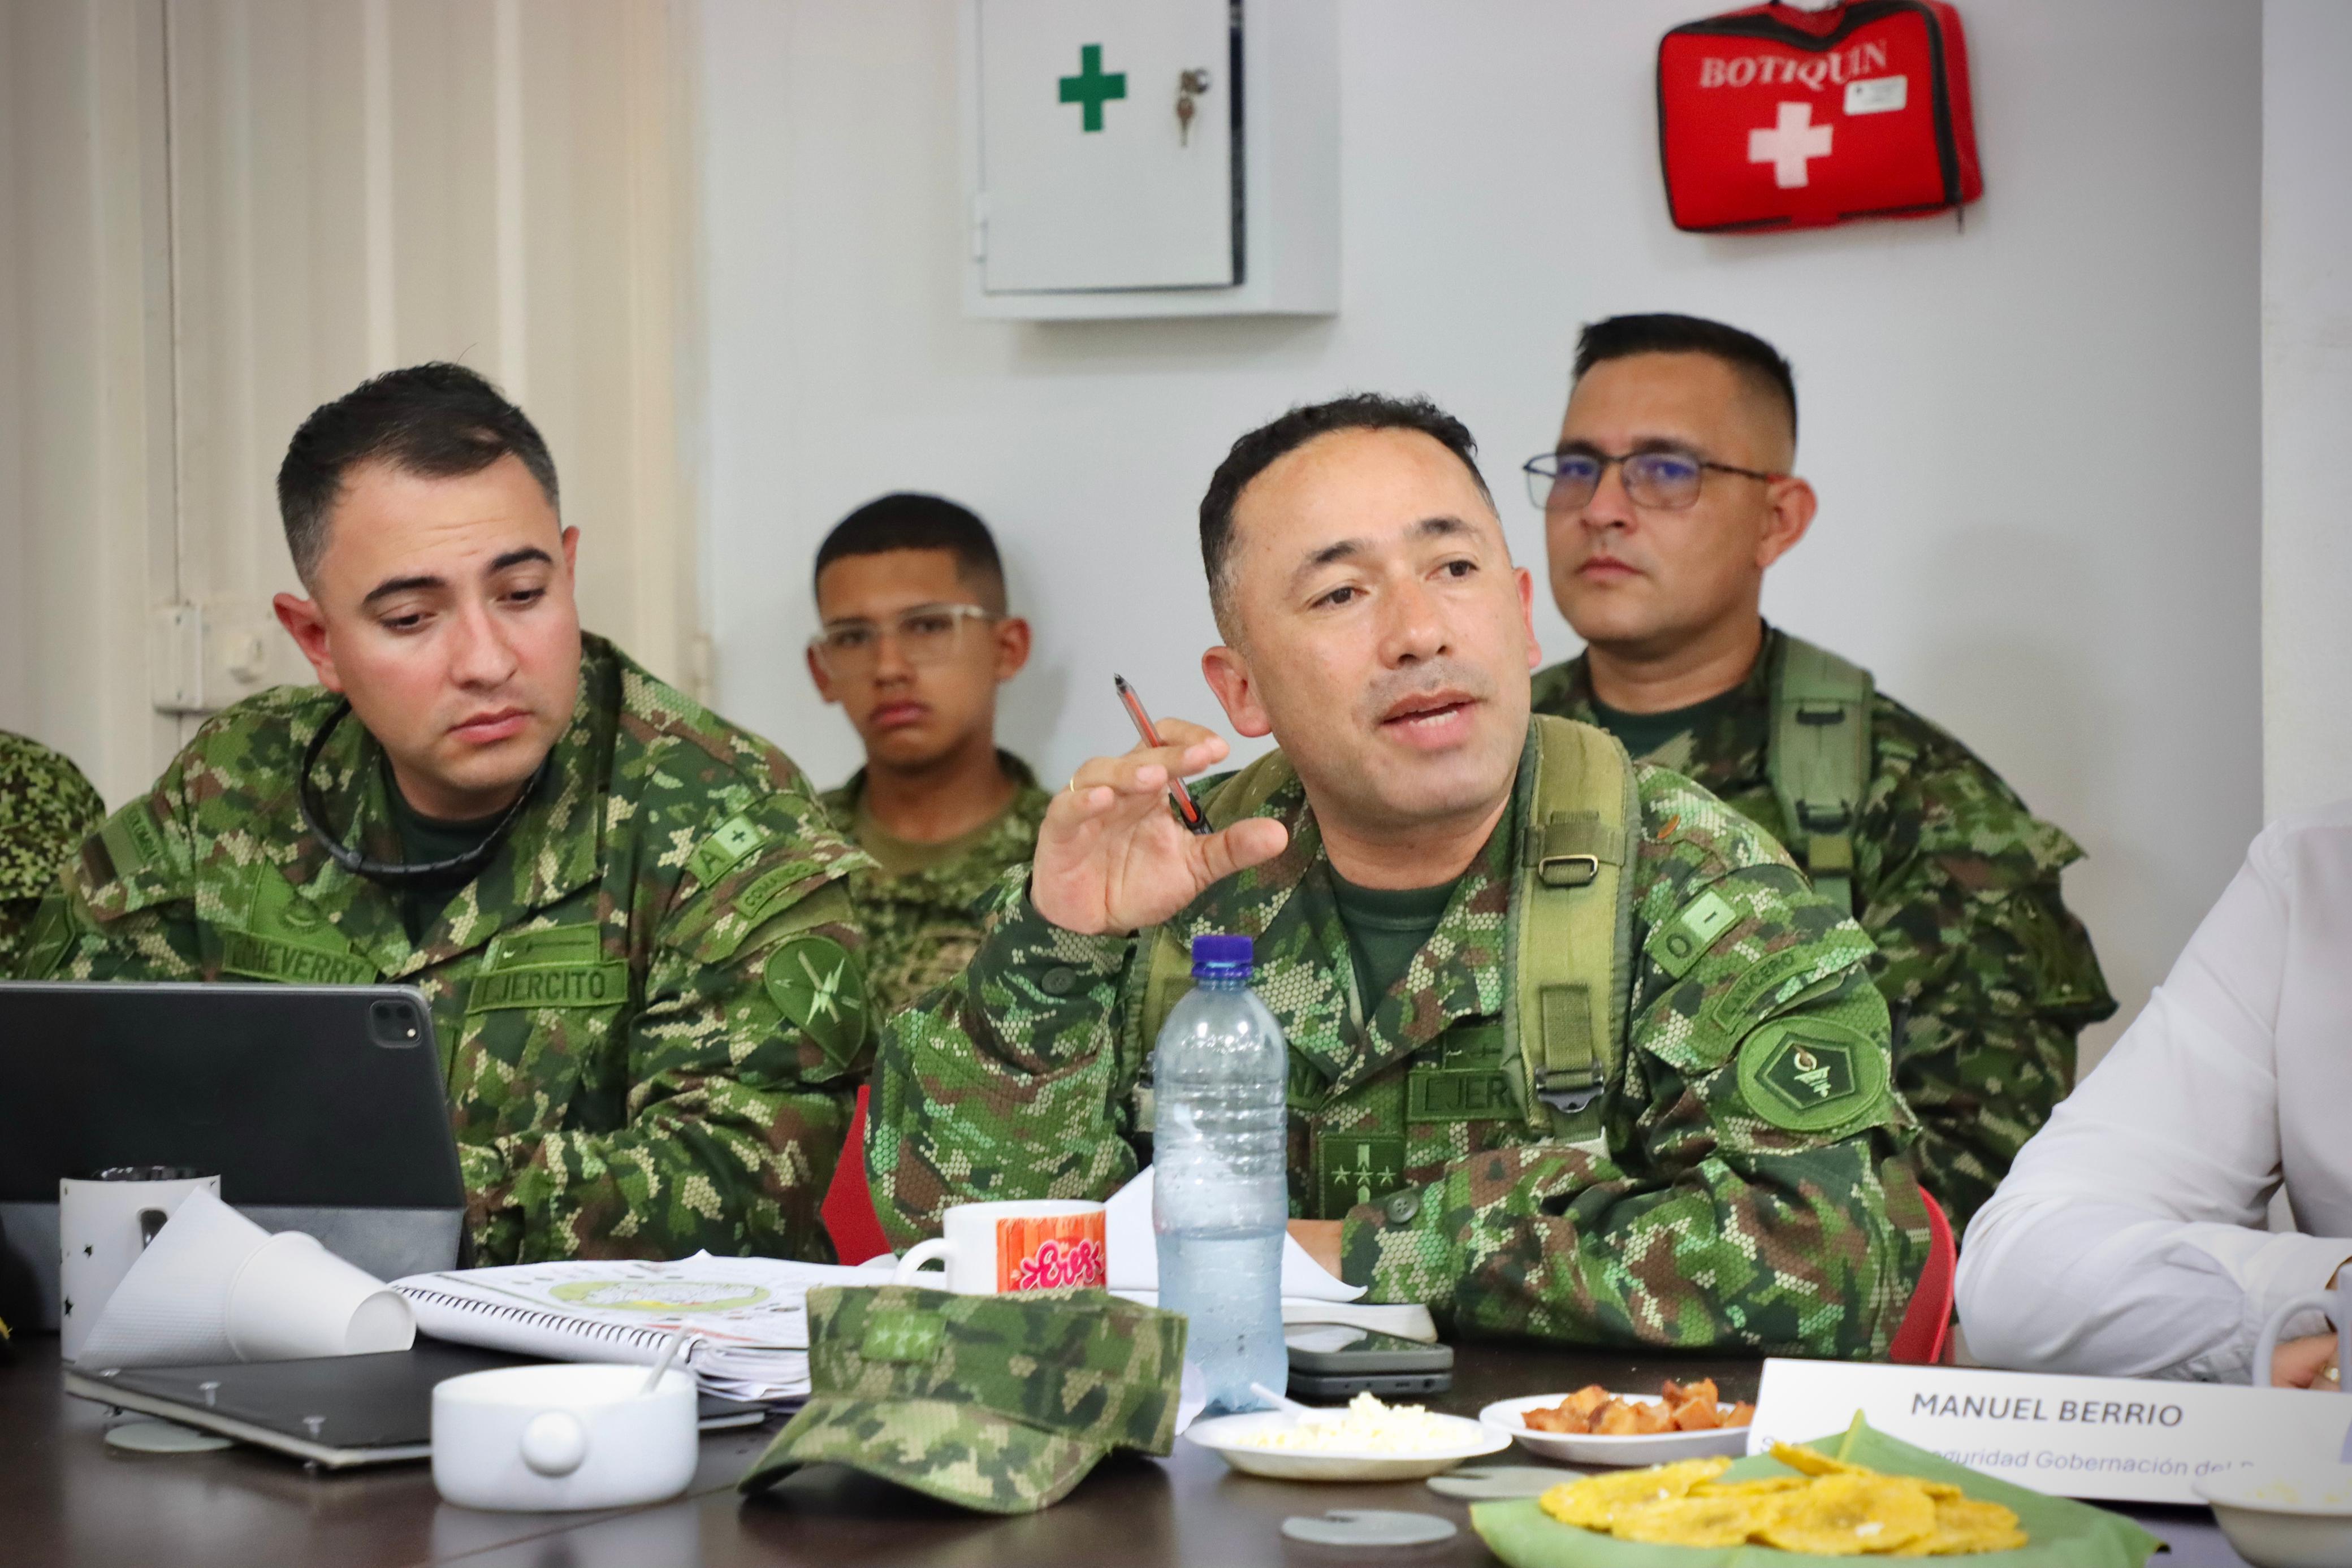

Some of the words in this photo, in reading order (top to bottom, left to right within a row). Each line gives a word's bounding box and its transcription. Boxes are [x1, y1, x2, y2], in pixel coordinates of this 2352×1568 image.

[482, 969, 606, 1005] EJERCITO
[1424, 1075, 1519, 1111] EJER
[1911, 1392, 2048, 1422] MANUEL
[2058, 1400, 2183, 1427] BERRIO
[2035, 1450, 2188, 1476] Gobernación
